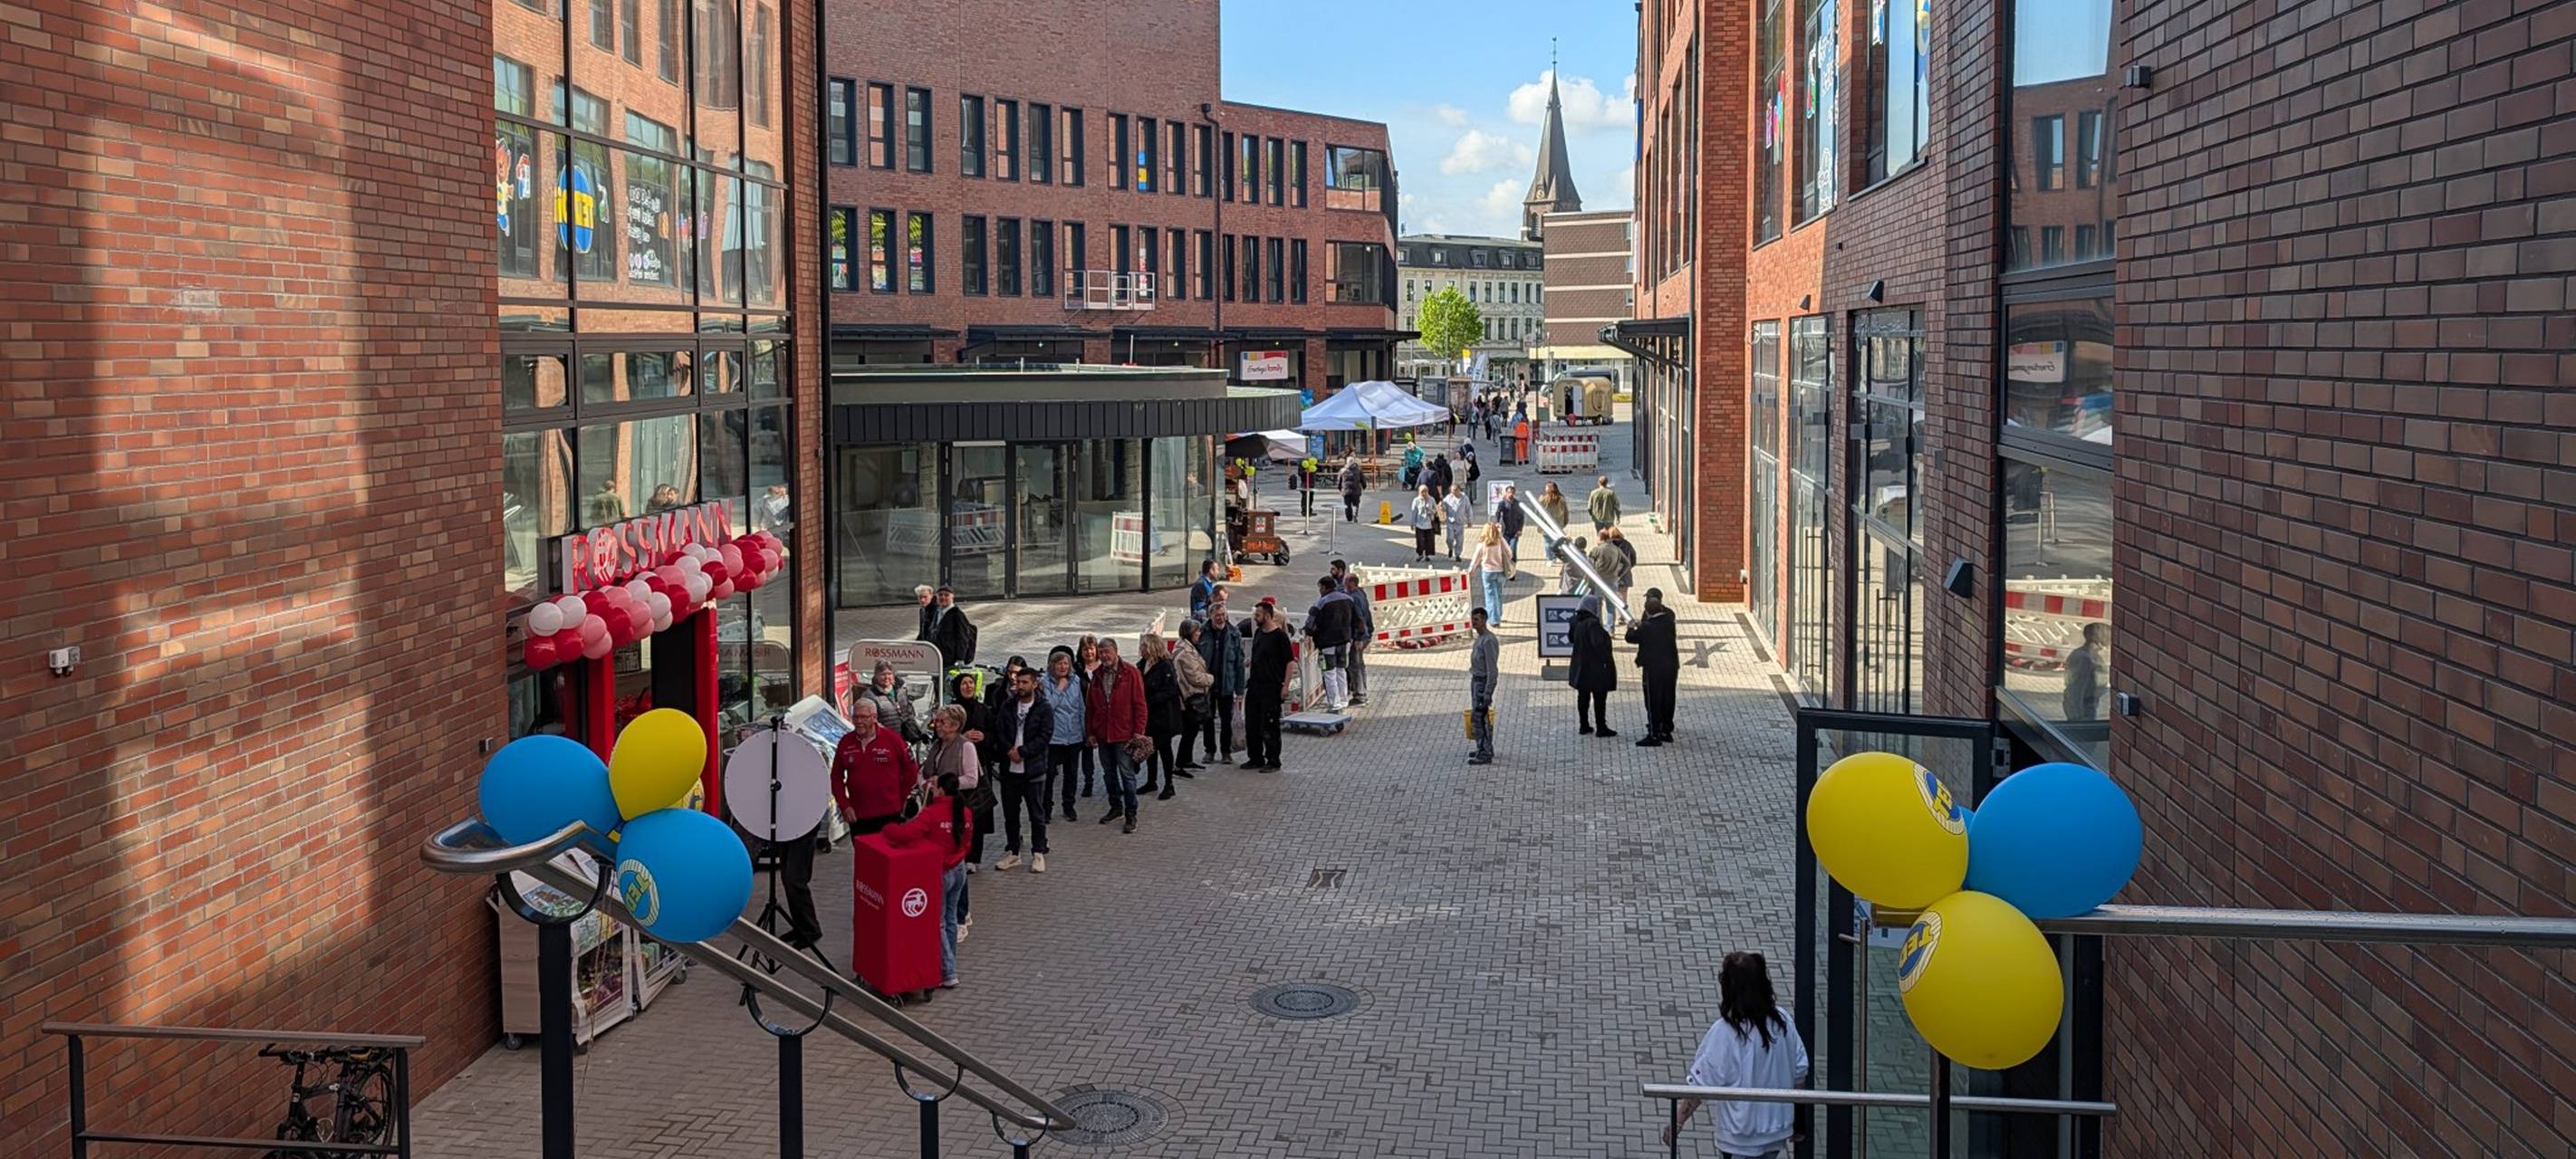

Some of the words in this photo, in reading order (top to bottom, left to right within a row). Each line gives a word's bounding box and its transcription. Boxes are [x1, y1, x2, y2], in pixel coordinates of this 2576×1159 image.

[568, 499, 733, 595] ROSSMANN
[865, 647, 924, 658] ROSSMANN
[625, 872, 651, 913] TED
[1899, 924, 1934, 968] TED
